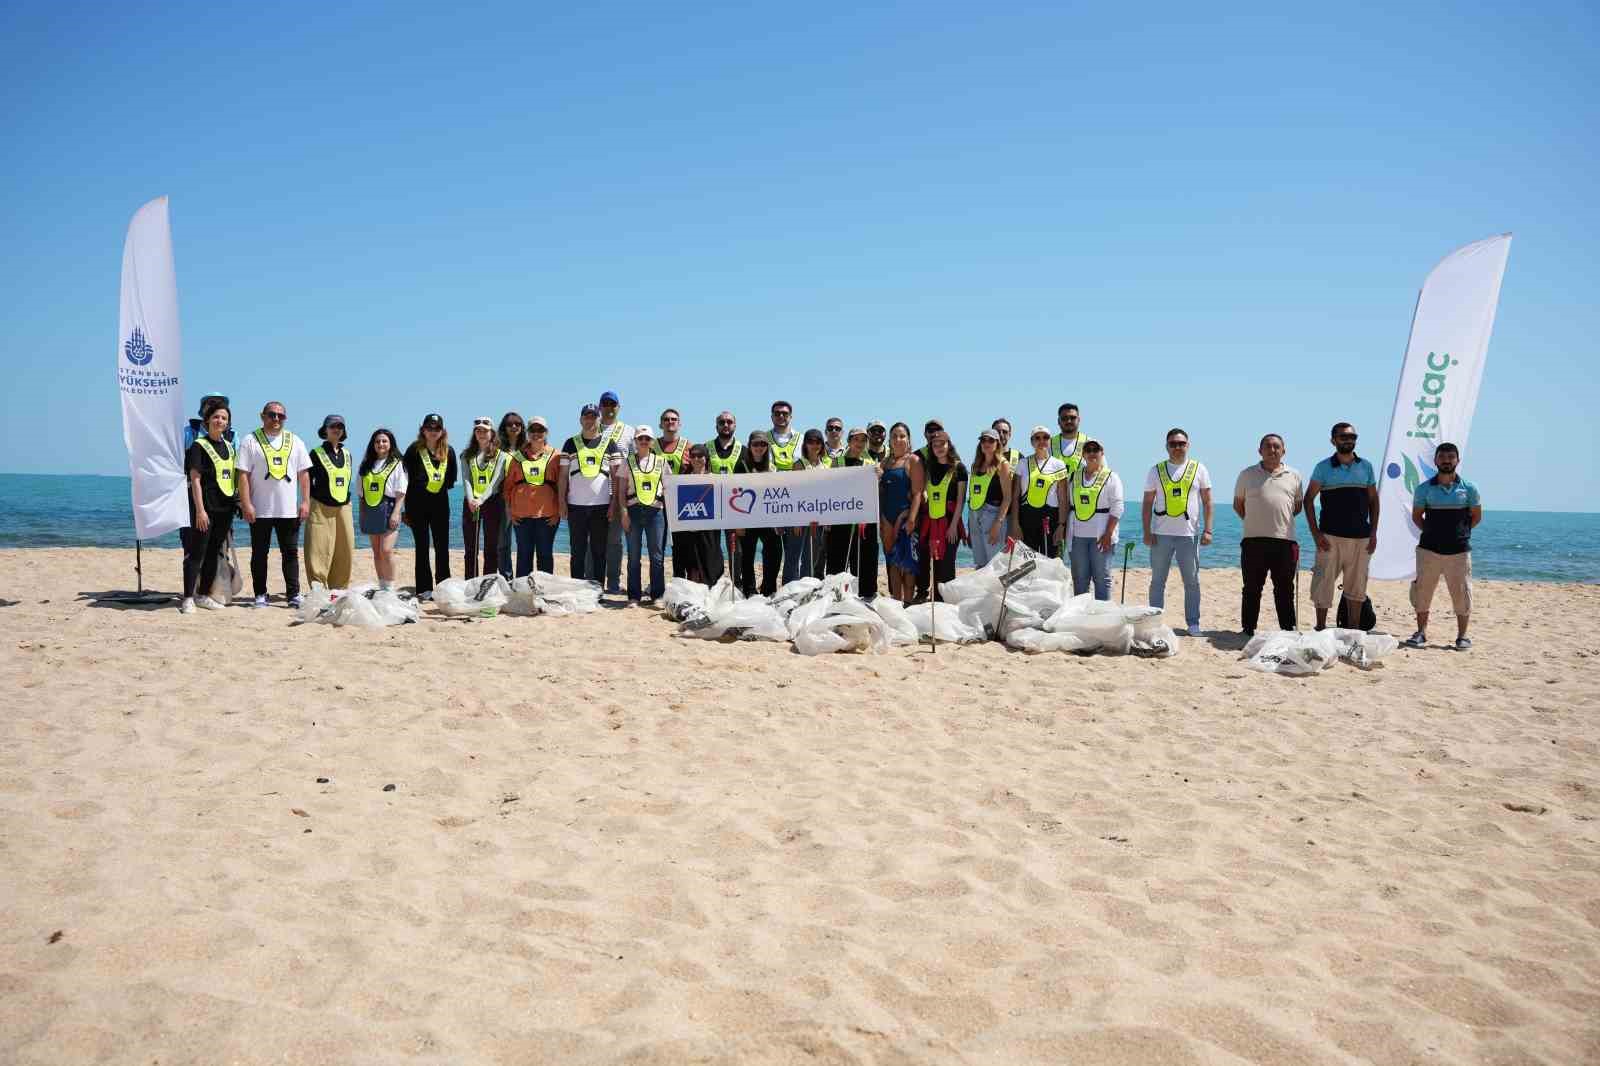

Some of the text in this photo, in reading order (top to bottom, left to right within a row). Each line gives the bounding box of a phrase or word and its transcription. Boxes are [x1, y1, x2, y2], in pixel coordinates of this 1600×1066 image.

[1406, 351, 1459, 439] istaç
[763, 487, 790, 500] AXA
[678, 501, 708, 517] AXA
[763, 497, 864, 515] Tüm Kalplerde
